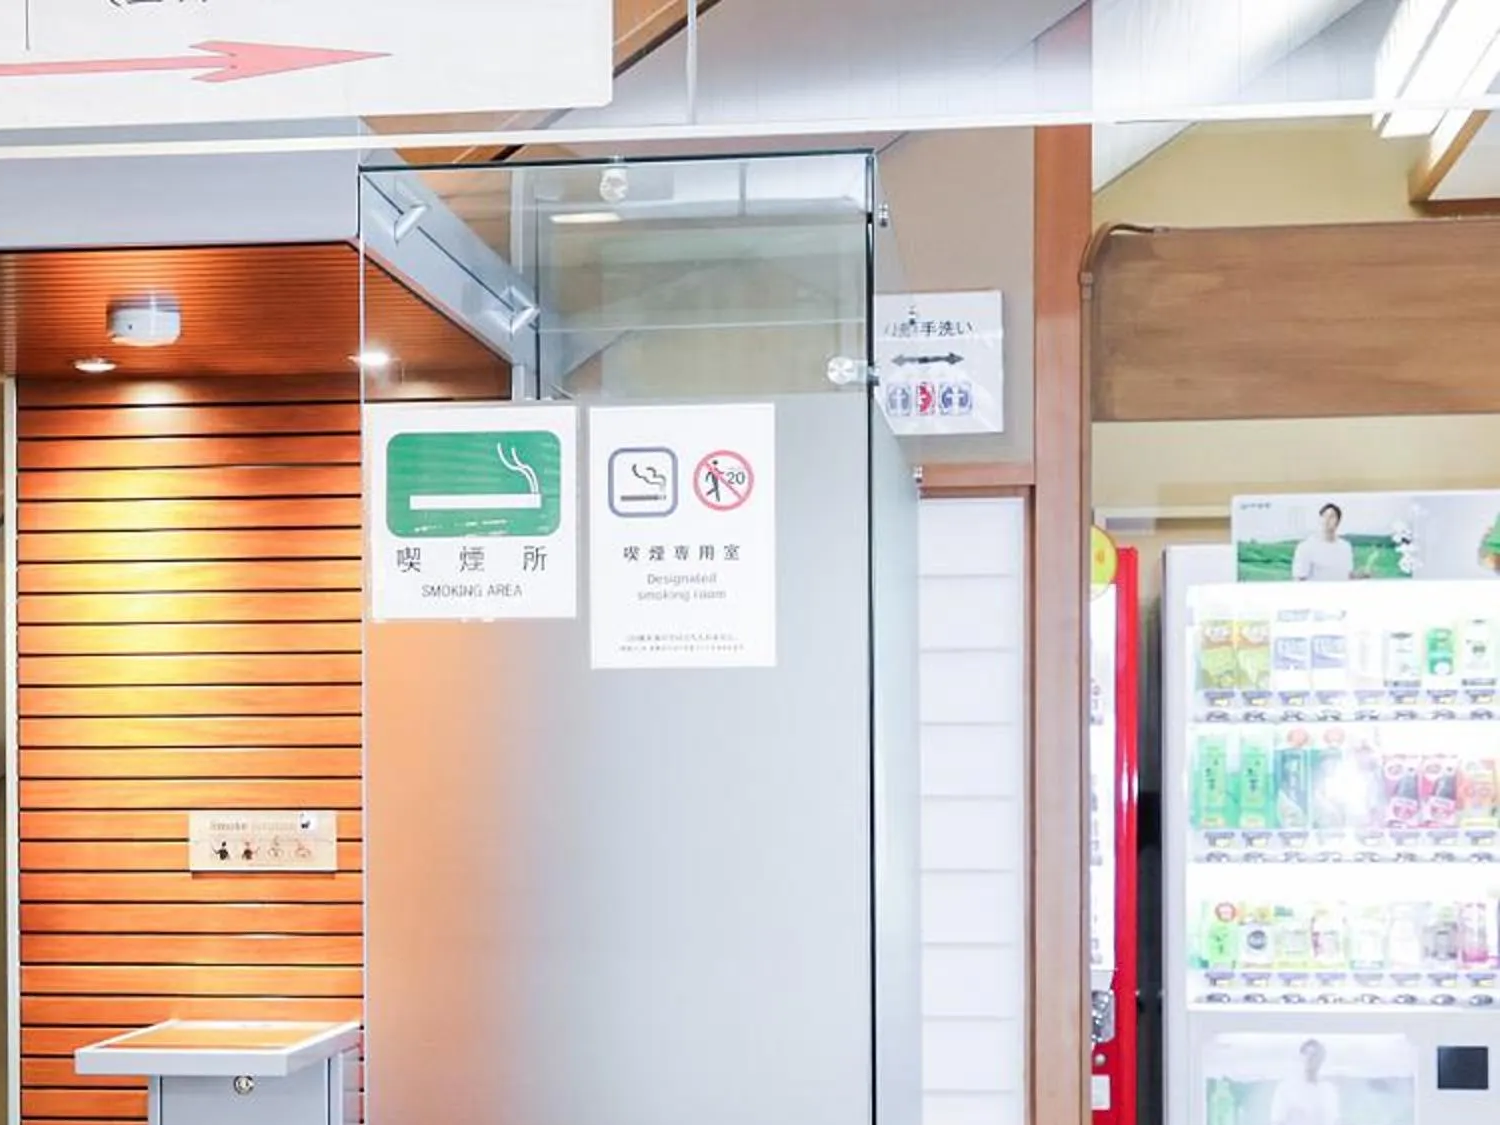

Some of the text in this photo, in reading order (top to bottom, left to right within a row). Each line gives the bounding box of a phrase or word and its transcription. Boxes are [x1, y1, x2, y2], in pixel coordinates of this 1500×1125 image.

[726, 471, 746, 485] 20
[396, 545, 548, 574] 喫煙所
[623, 543, 740, 562] 喫煙専用室
[646, 572, 717, 587] Designated
[421, 583, 523, 598] SMOKING AREA
[637, 589, 727, 603] smoking room
